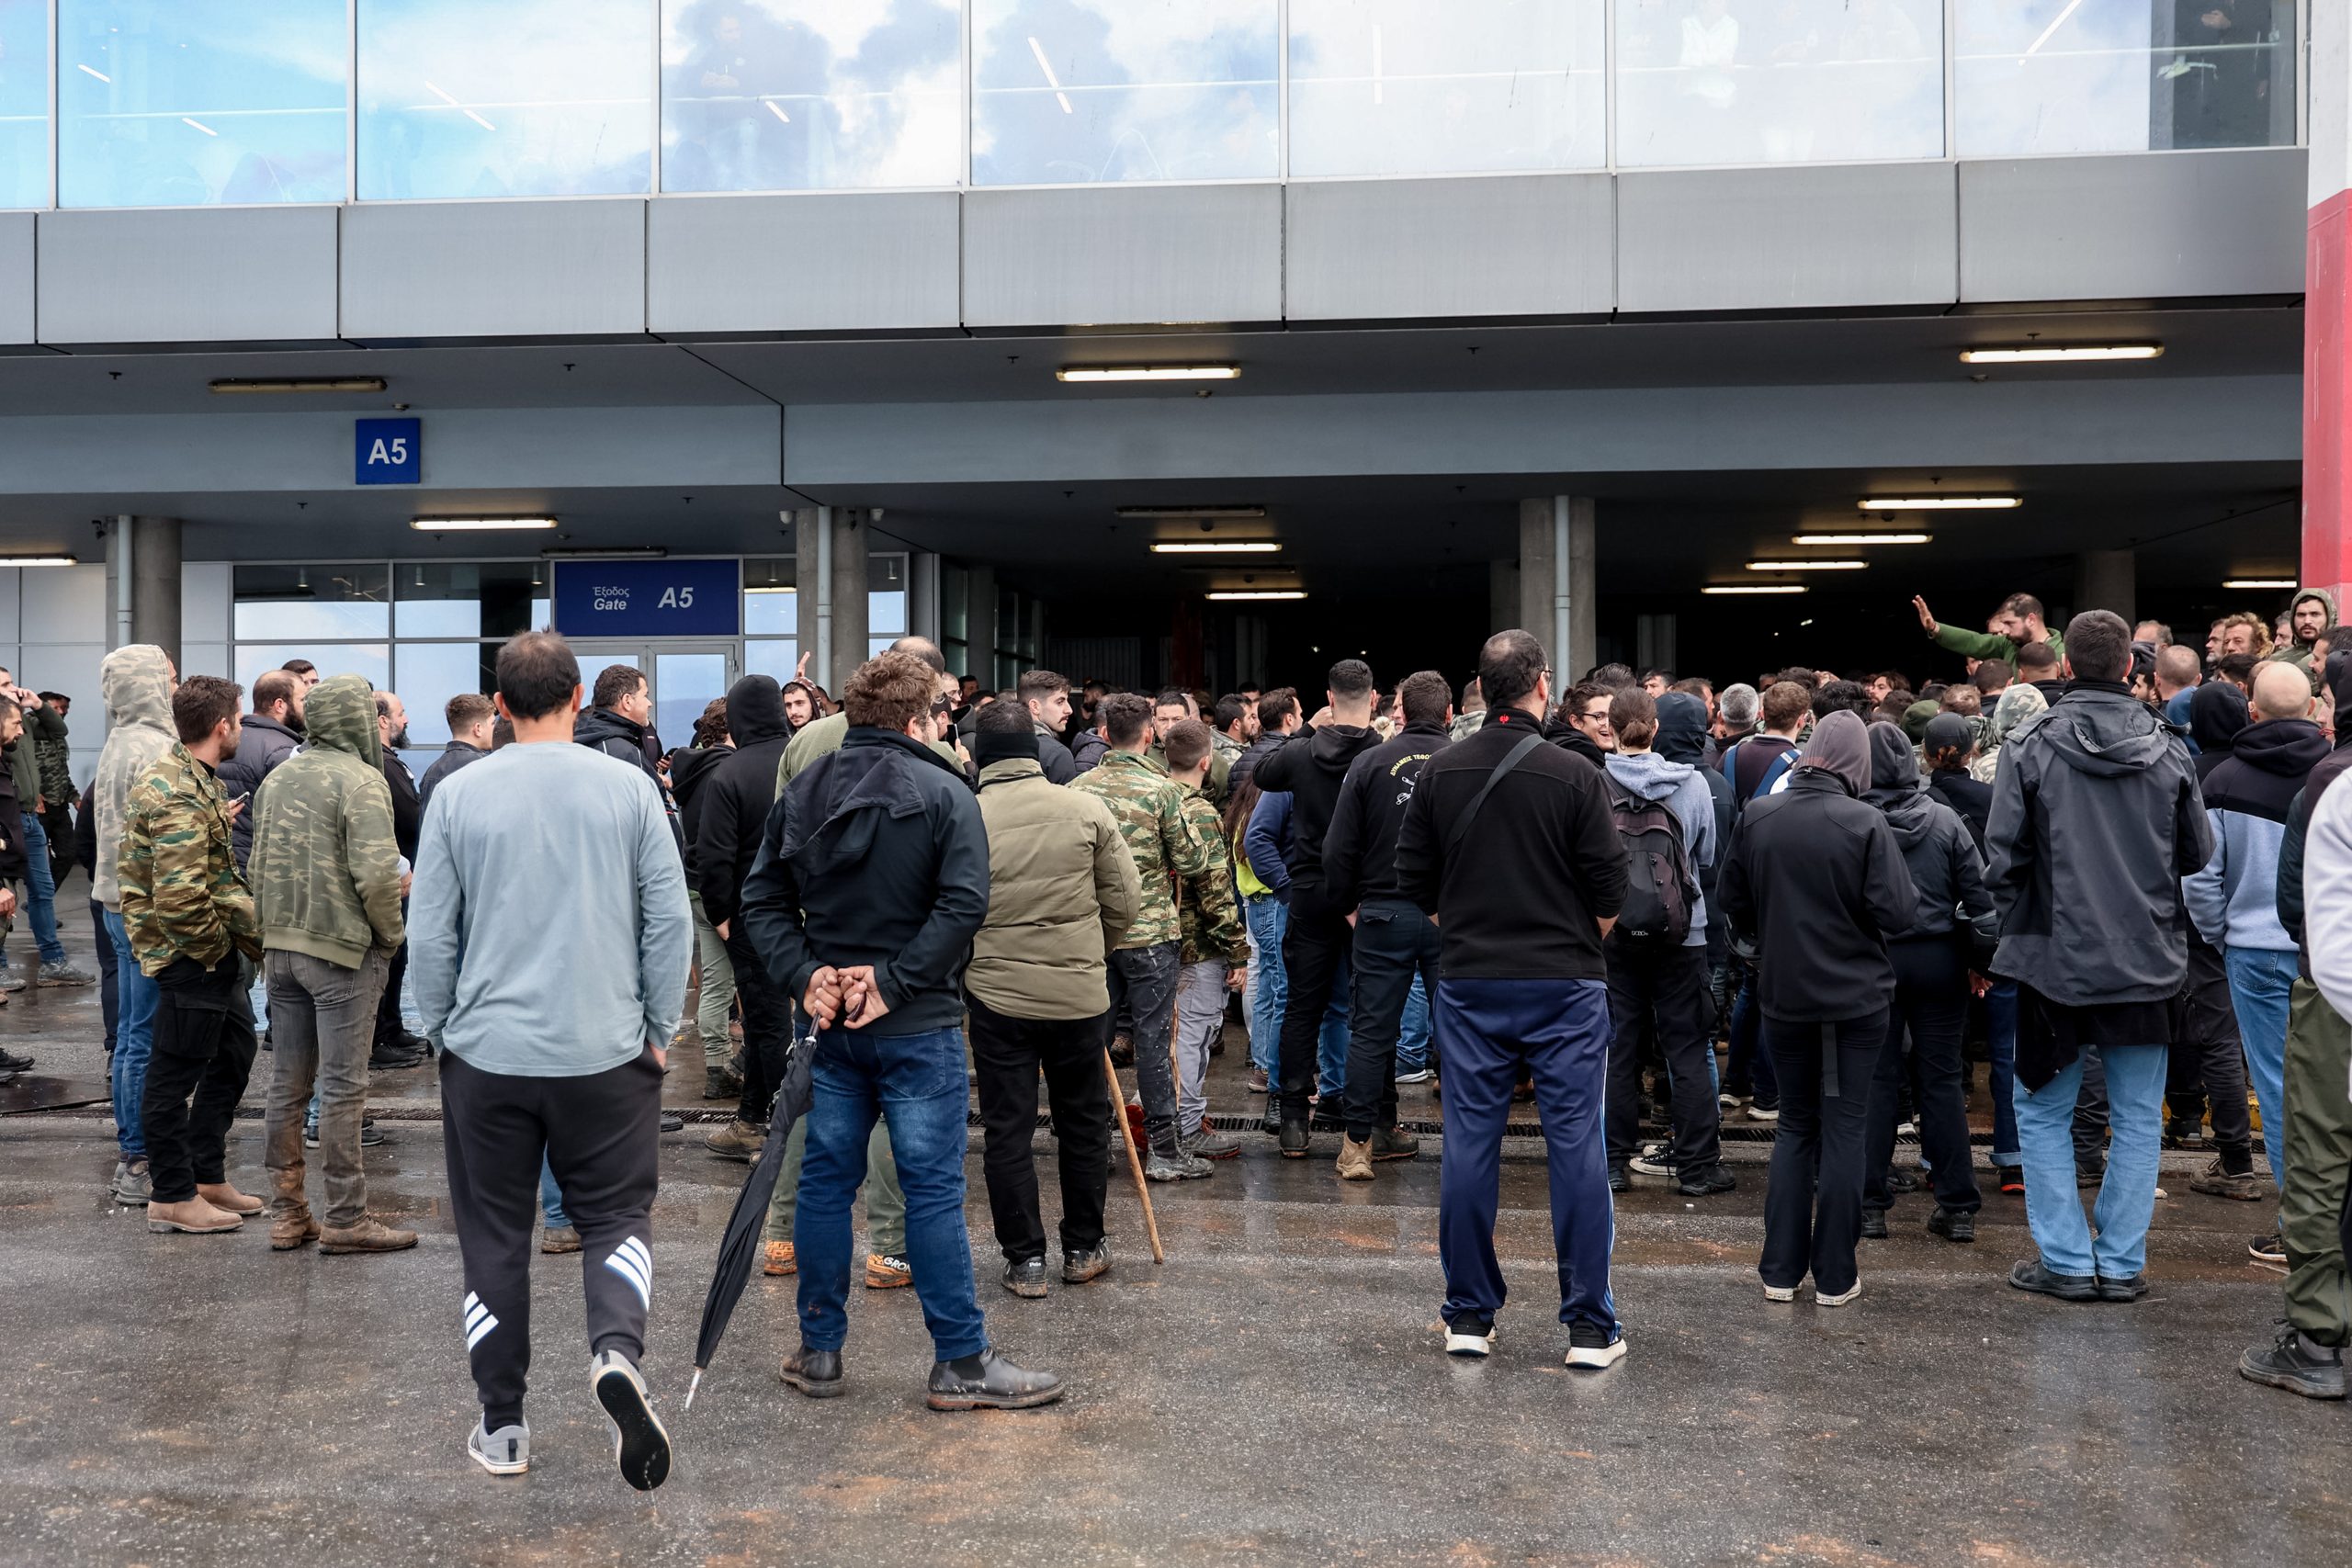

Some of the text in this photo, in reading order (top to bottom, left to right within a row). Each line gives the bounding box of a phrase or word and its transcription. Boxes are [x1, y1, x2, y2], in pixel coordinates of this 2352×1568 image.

[368, 438, 407, 465] A5
[593, 586, 630, 598] Έξοδος
[658, 587, 694, 608] A5
[594, 598, 627, 611] Gate
